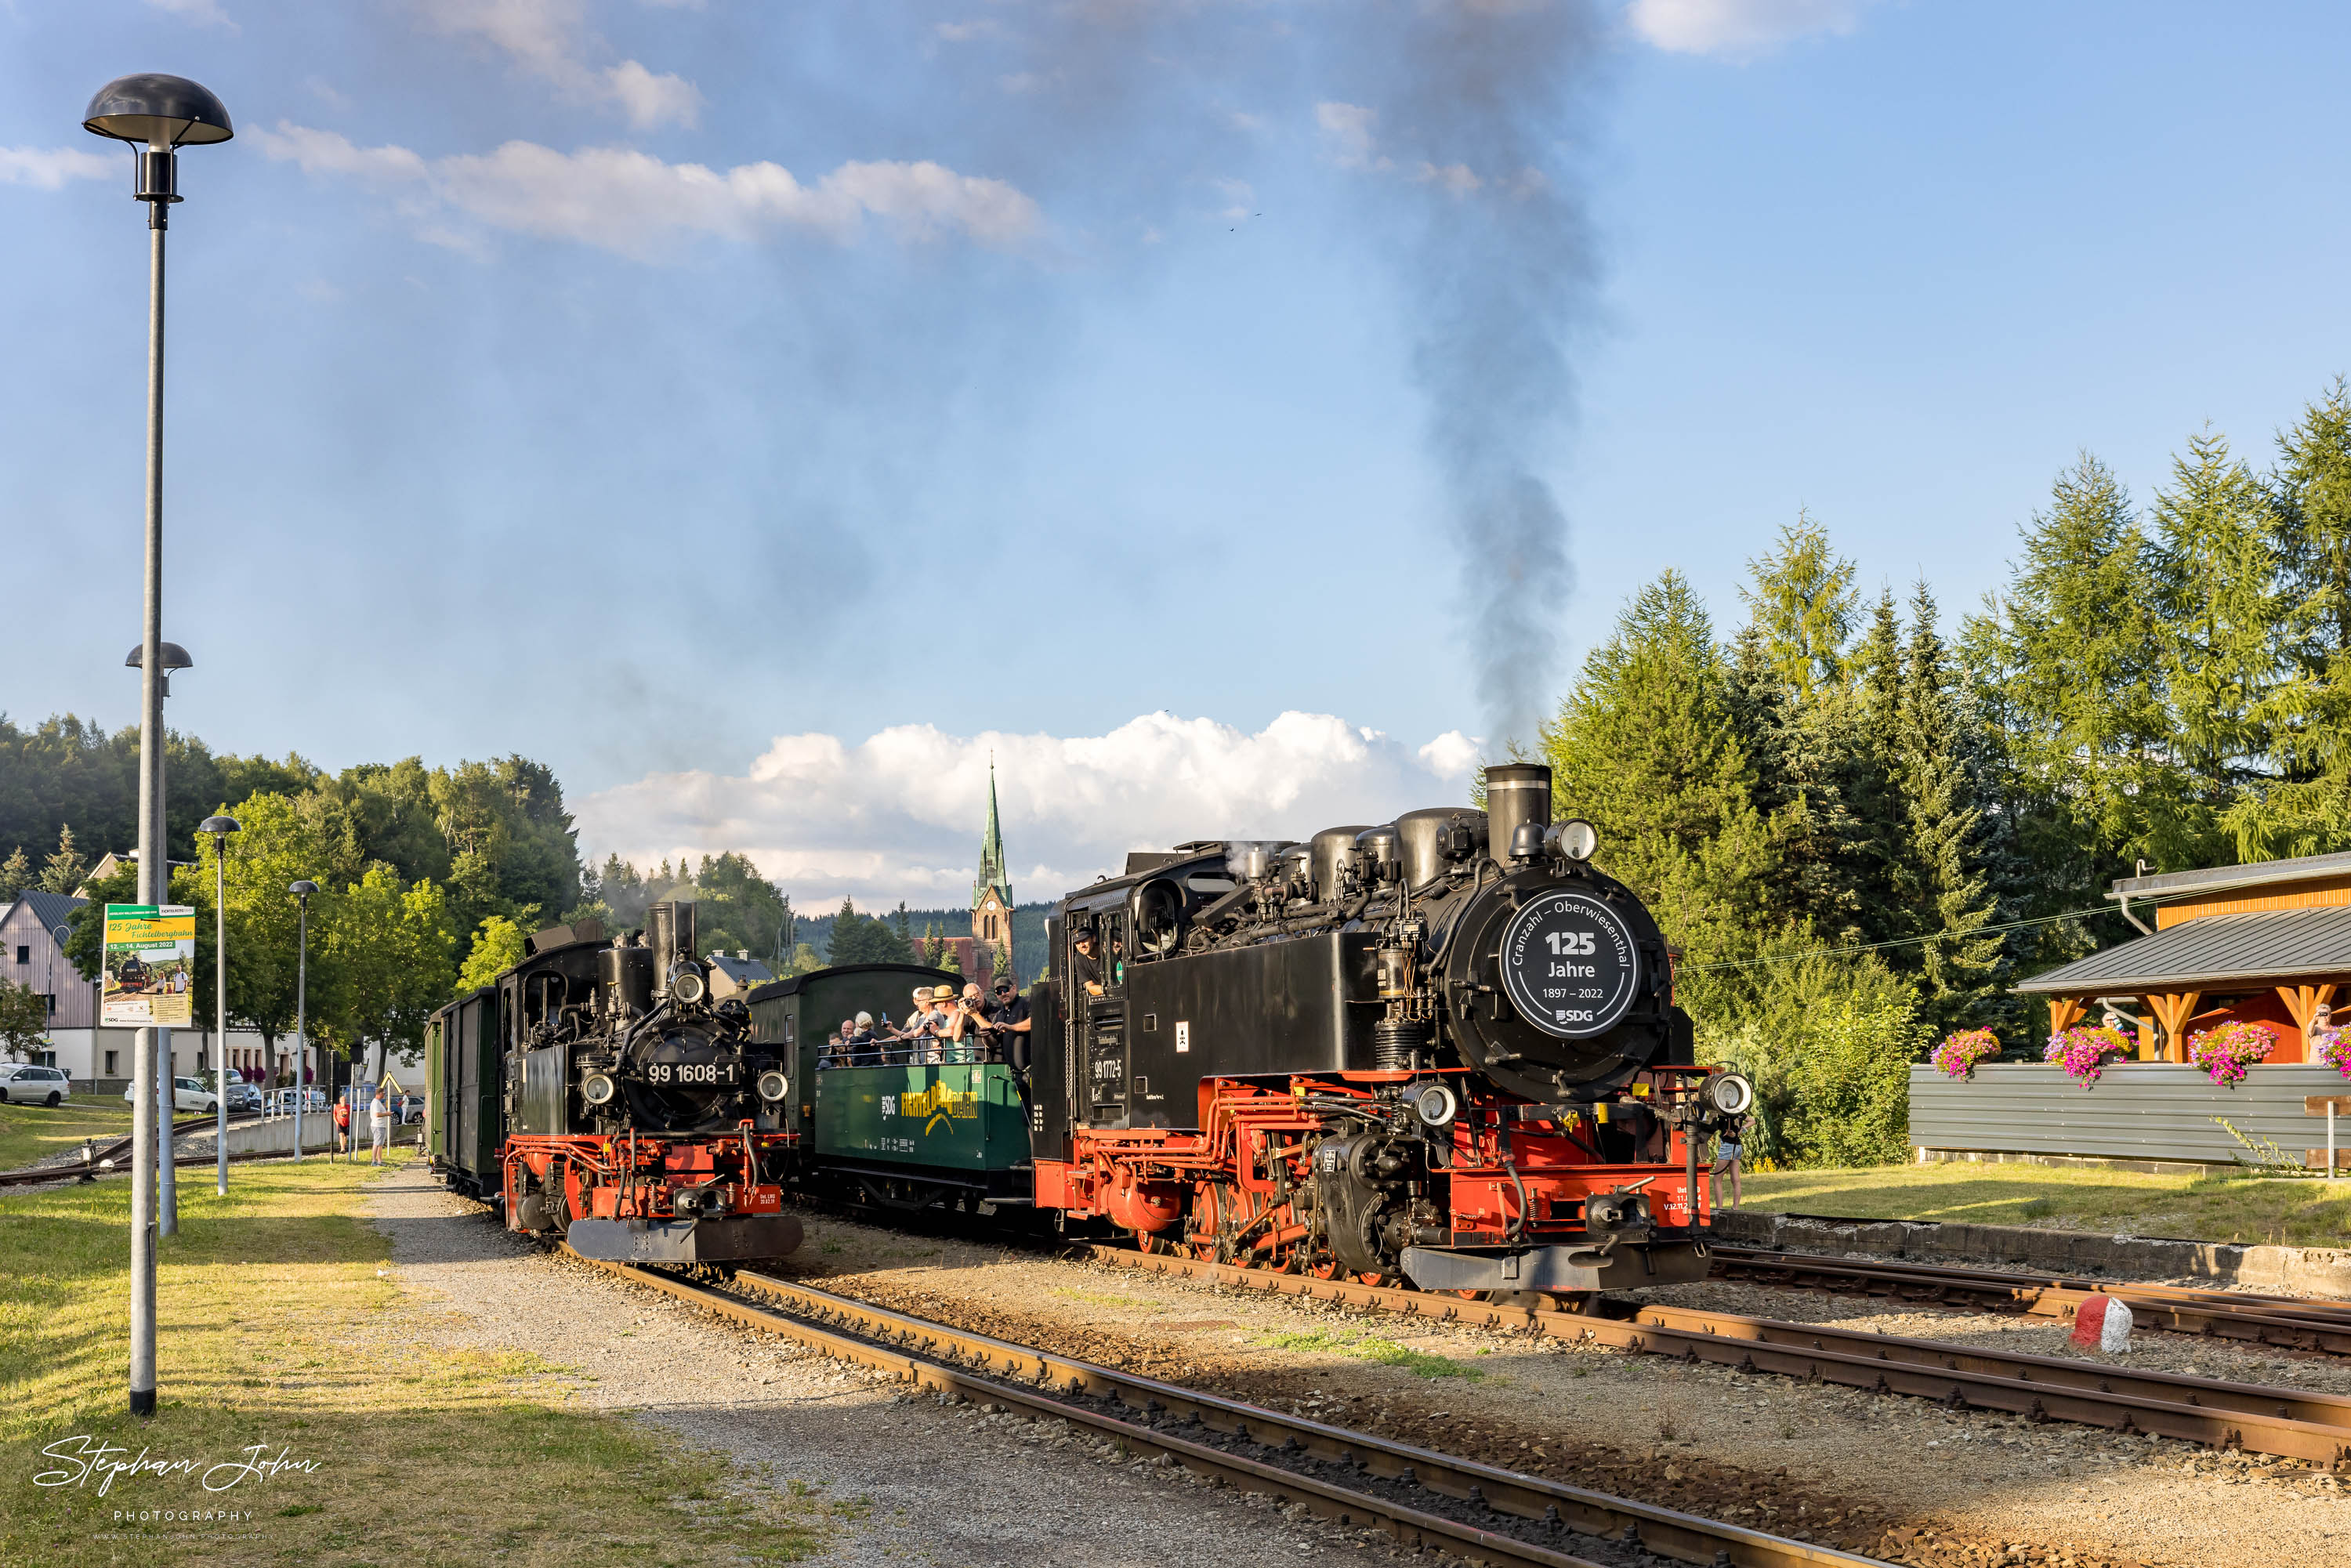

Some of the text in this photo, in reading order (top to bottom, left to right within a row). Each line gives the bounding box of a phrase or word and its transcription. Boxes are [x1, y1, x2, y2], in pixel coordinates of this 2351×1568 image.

[125, 922, 153, 932] Jahre
[132, 929, 193, 939] Fichtelbergbahn
[1512, 911, 1543, 965] Cranzahl
[1554, 901, 1630, 967] Oberwiesenthal
[1545, 932, 1596, 955] 125
[1548, 961, 1596, 978] Jahre
[1542, 988, 1567, 998] 1897
[1578, 988, 1604, 998] 2022
[1564, 1009, 1593, 1022] SDG
[648, 1063, 734, 1082] 99 1608-1
[1095, 1059, 1121, 1079] 99 1772-5
[885, 1095, 896, 1115] SDG
